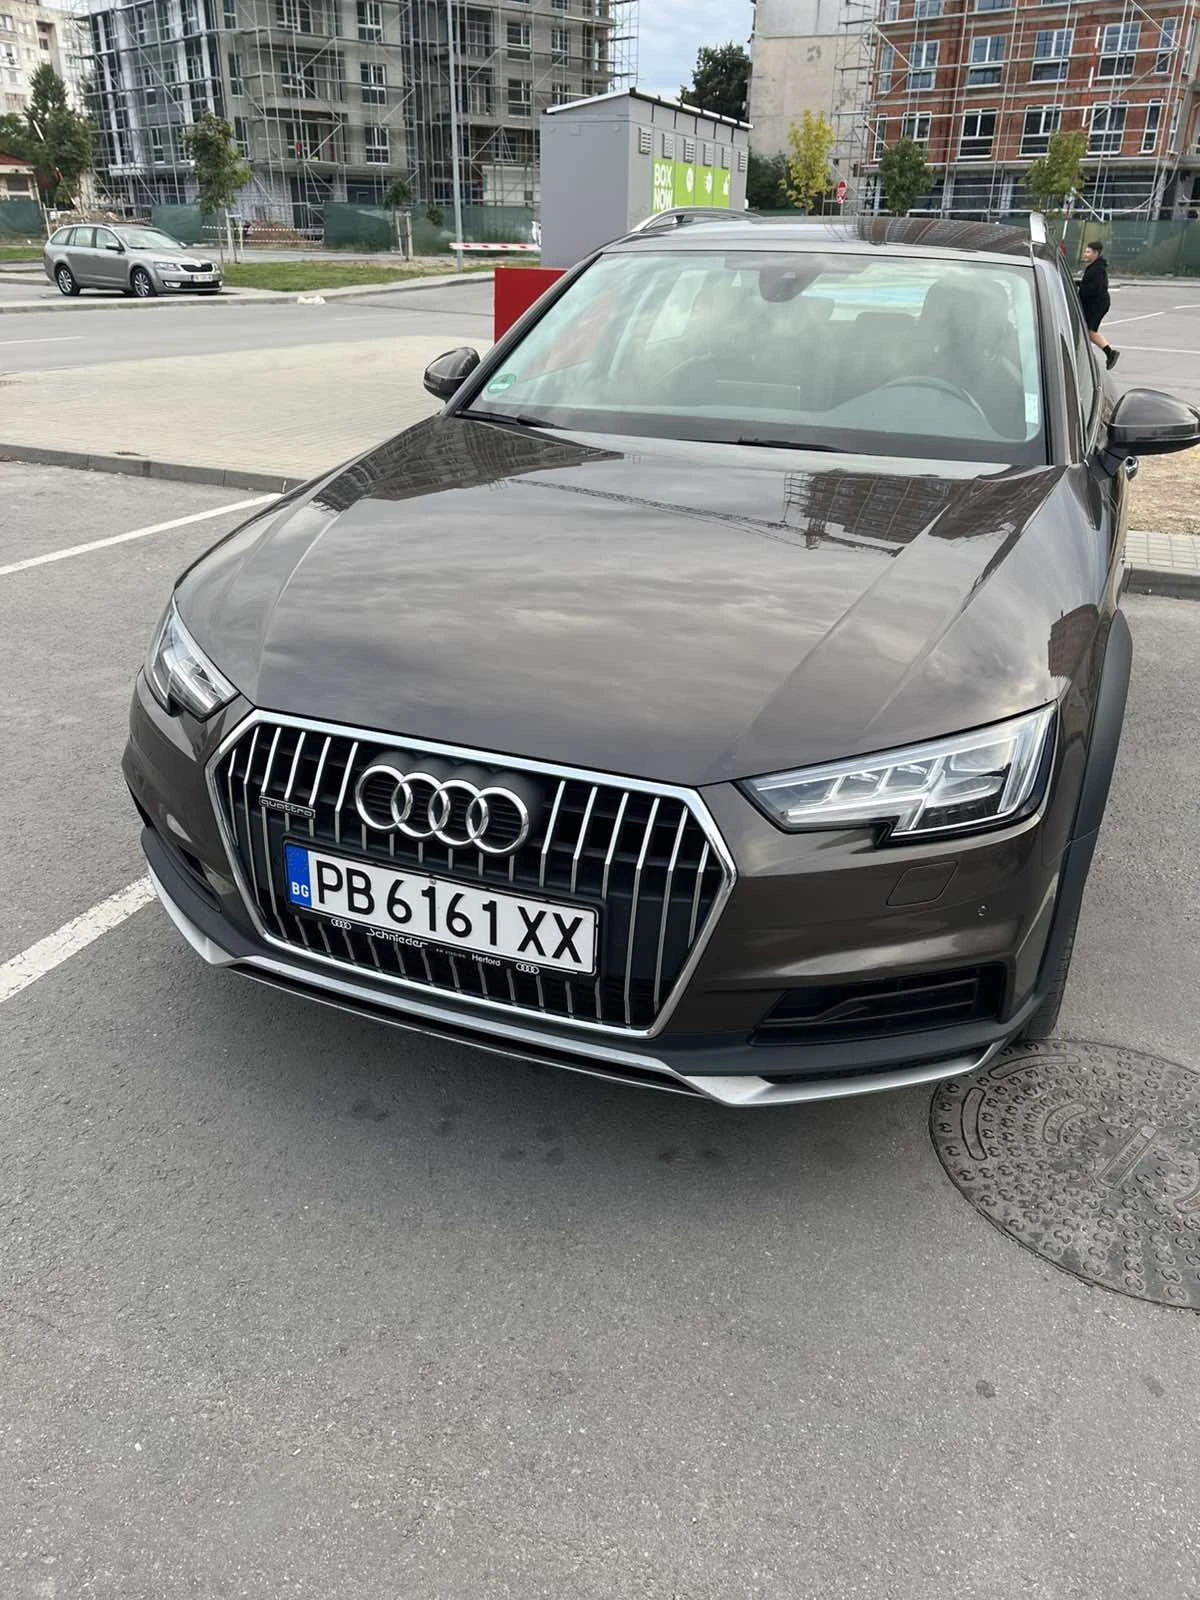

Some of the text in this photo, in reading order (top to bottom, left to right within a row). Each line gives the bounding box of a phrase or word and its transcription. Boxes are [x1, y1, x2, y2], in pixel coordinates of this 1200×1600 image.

[655, 165, 672, 187] BOX
[654, 188, 673, 210] NOW
[261, 799, 312, 817] quattro
[291, 882, 309, 898] BG
[366, 928, 428, 948] Schnieder
[517, 906, 583, 963] XX
